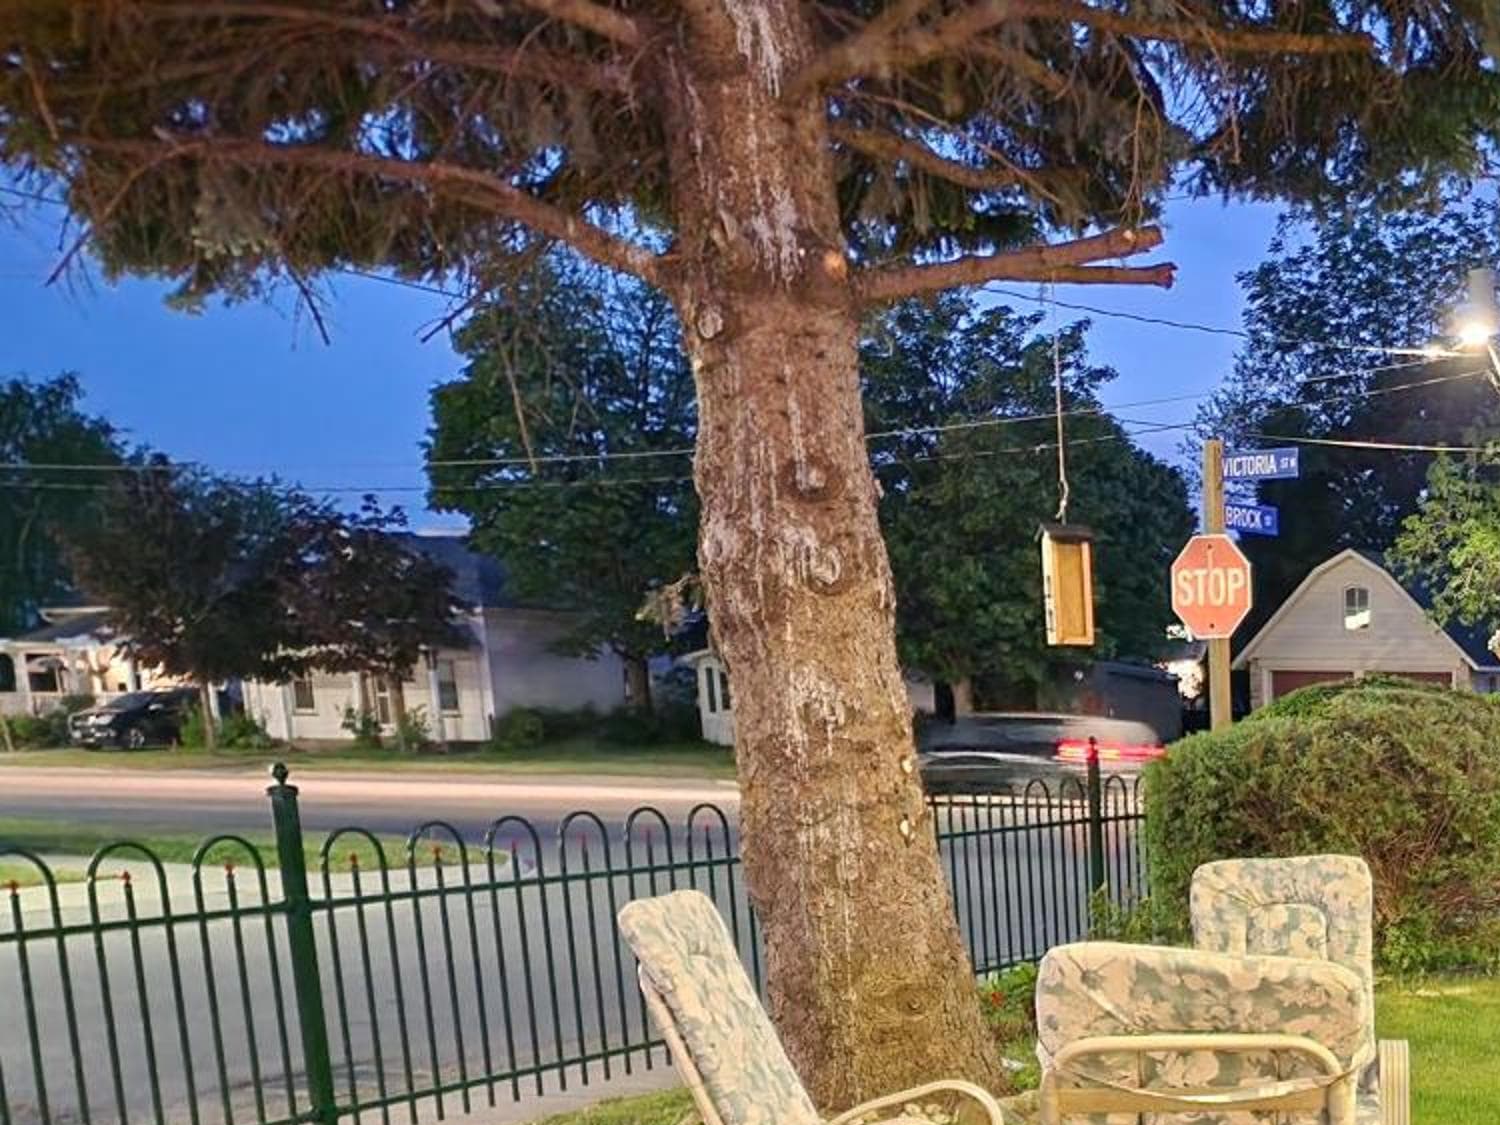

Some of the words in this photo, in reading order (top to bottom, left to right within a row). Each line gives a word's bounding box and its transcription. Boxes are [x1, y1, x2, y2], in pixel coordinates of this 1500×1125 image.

[1222, 454, 1277, 477] VICTORIA
[1225, 505, 1263, 529] BROCK
[1176, 567, 1245, 607] STOP
